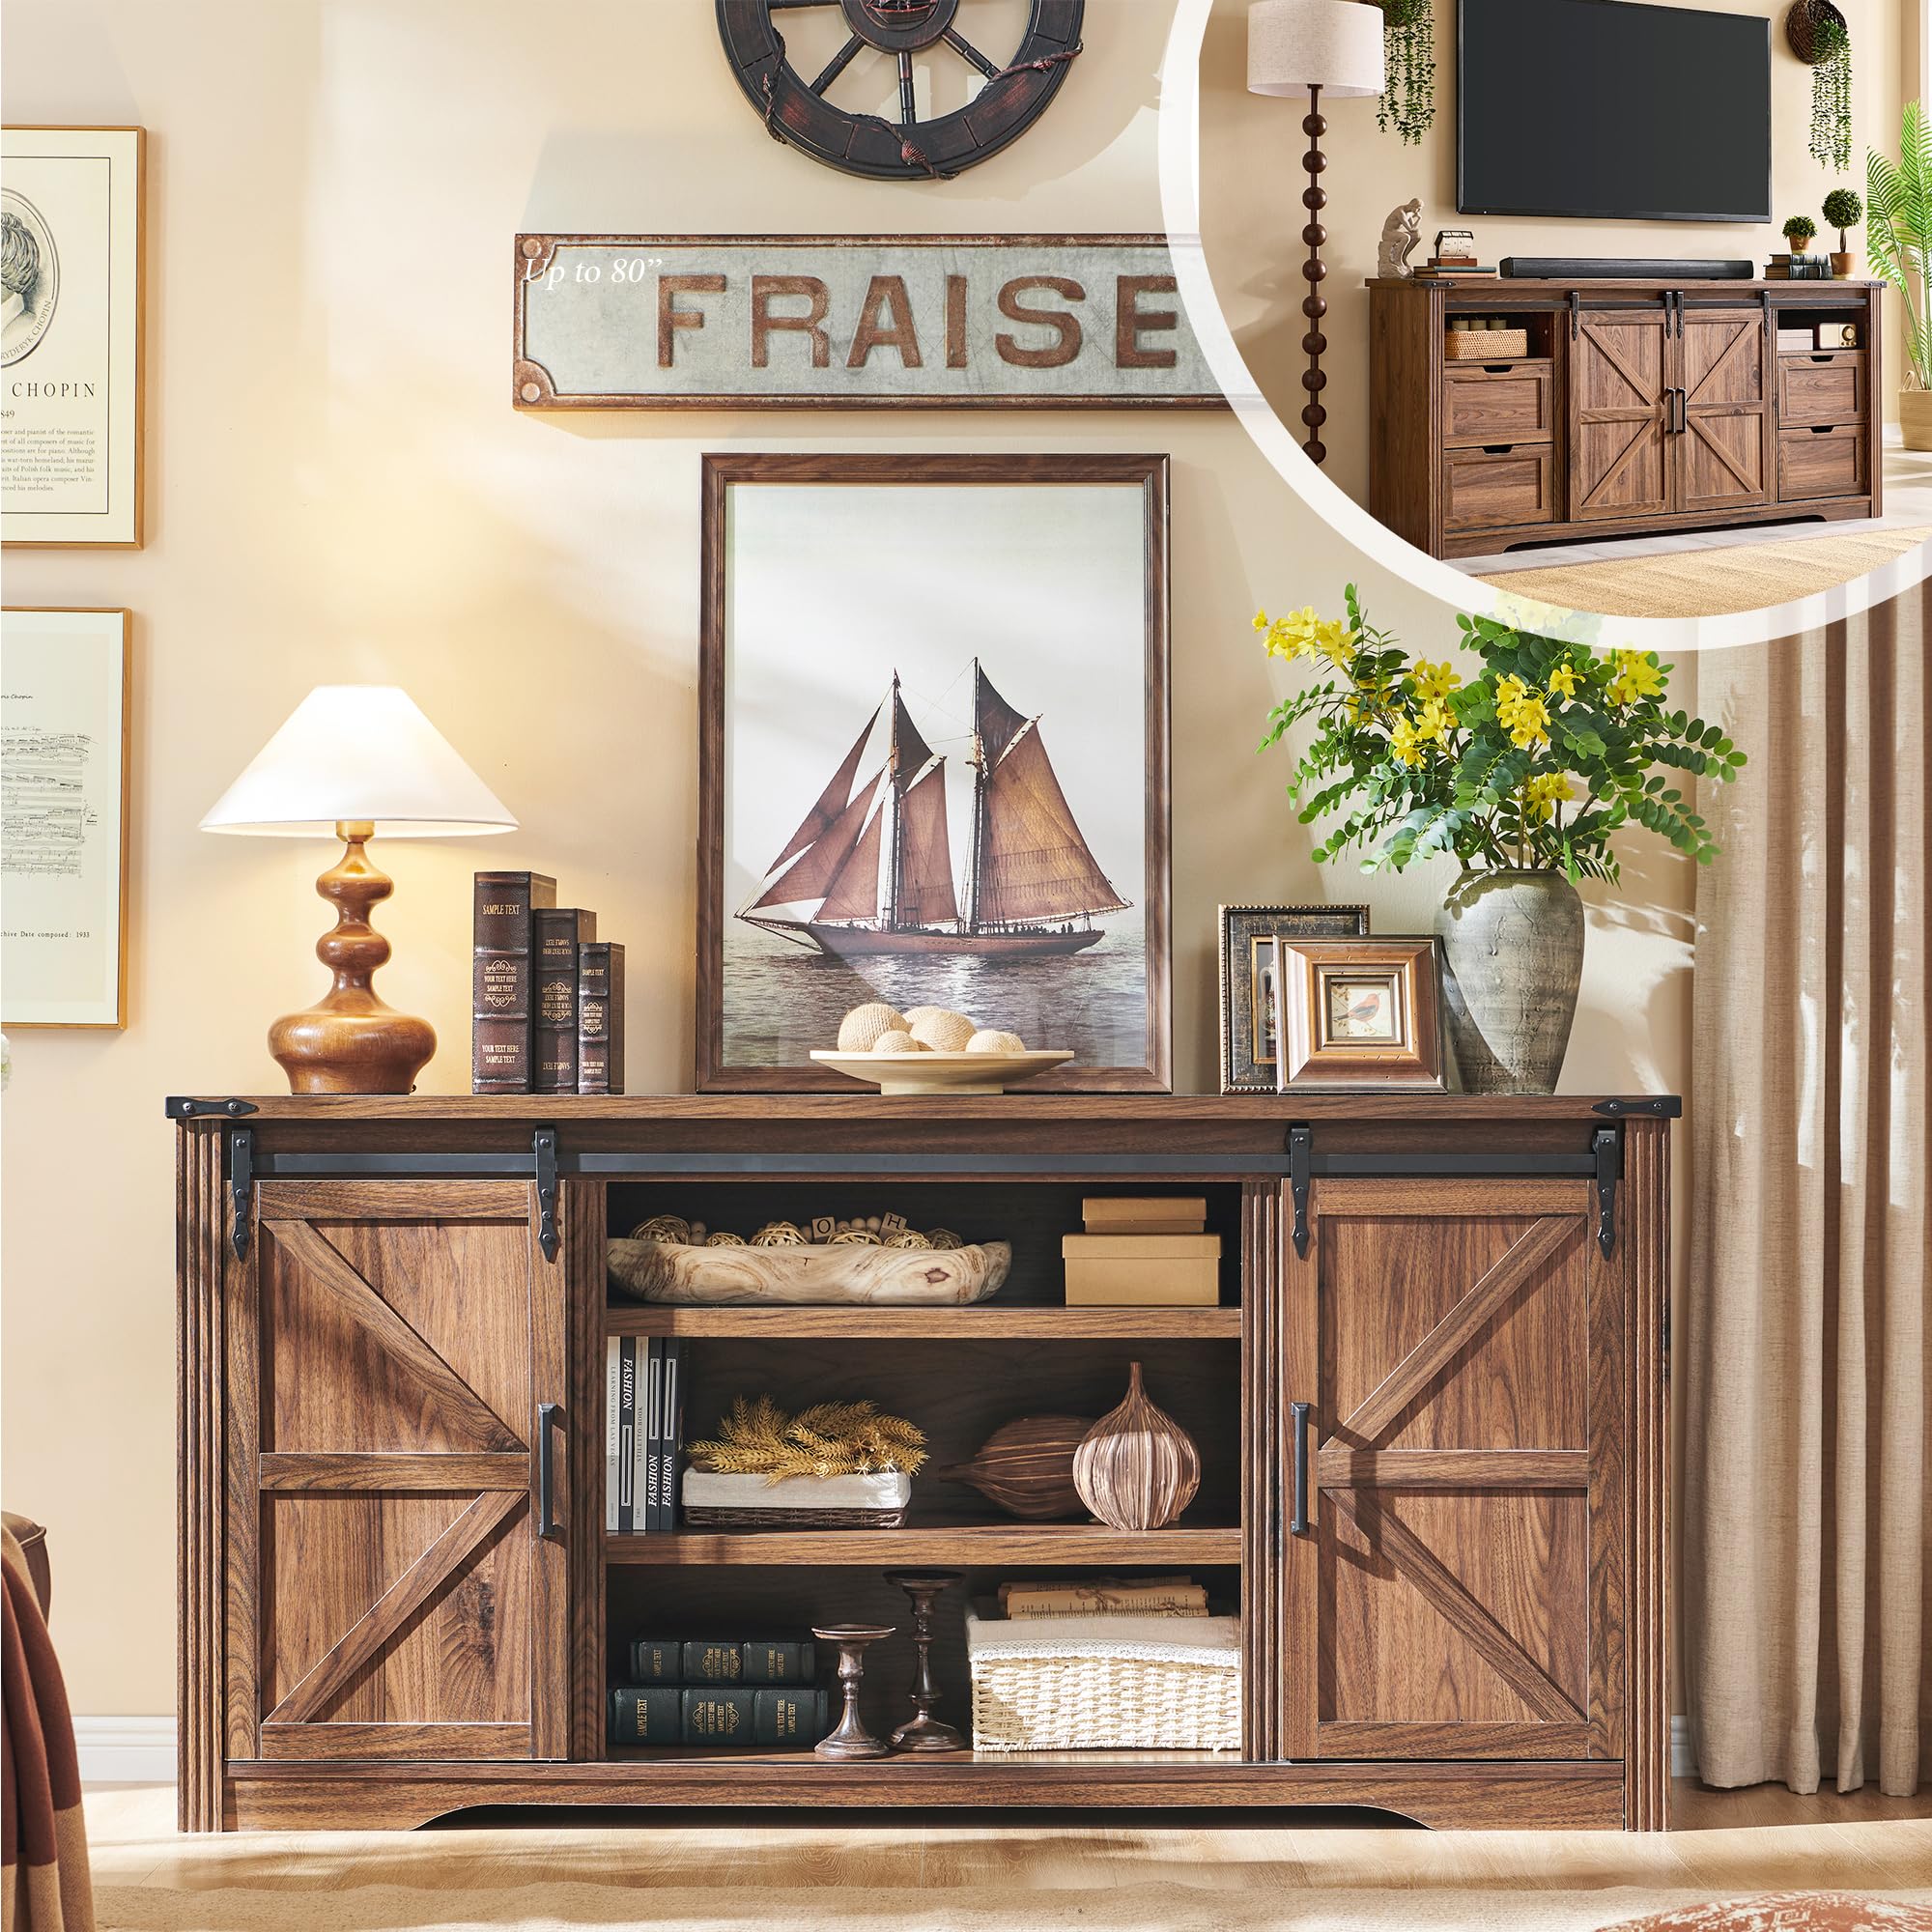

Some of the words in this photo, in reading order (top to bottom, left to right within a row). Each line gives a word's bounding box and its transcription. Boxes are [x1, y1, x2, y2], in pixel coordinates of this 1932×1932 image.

[32, 300, 51, 336] CHOPIN
[657, 274, 1179, 369] FRAISE
[12, 382, 95, 398] CHOPIN
[69, 447, 96, 456] Although
[482, 904, 504, 916] SAMPLE
[504, 904, 520, 916] TEXT
[482, 1044, 495, 1053] YOUR
[495, 1044, 506, 1053] TEXT
[506, 1044, 520, 1053] HERE
[486, 1055, 503, 1064] SAMPLE
[503, 1055, 515, 1064] TEXT
[887, 1214, 901, 1230] H
[623, 1358, 633, 1410] FASHION
[648, 1454, 658, 1507] FASHION
[662, 1454, 673, 1507] FASHION
[638, 1699, 647, 1714] TEXT
[638, 1714, 647, 1736] SAMPLE
